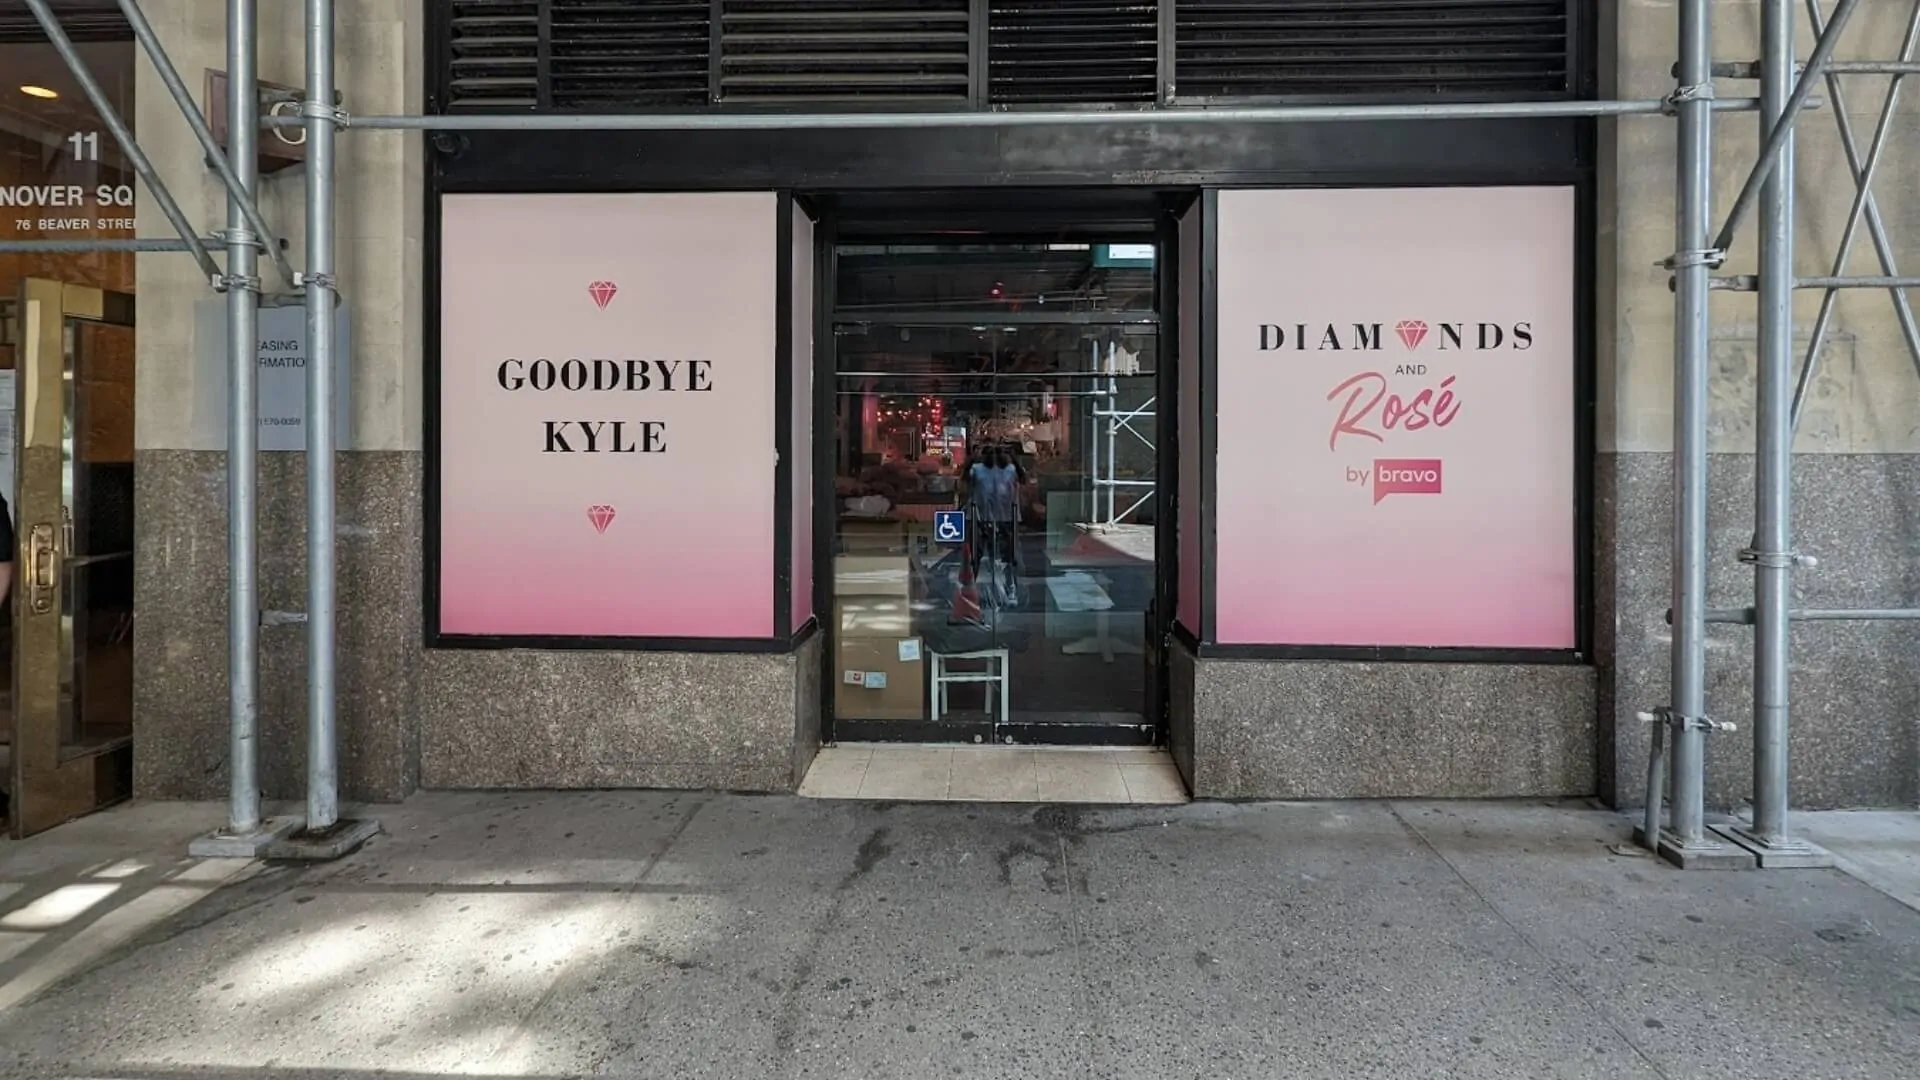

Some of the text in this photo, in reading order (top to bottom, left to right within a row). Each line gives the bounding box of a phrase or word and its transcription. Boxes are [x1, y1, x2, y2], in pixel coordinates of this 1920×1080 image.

[68, 131, 98, 160] 11
[0, 184, 133, 206] NOVER SQ
[16, 219, 31, 230] 76
[38, 218, 89, 229] BEAVER
[498, 358, 712, 392] GOODBYE
[1395, 364, 1427, 375] AND
[1327, 371, 1462, 452] Rosé
[542, 421, 667, 453] KYLE
[1346, 465, 1438, 486] by bravo
